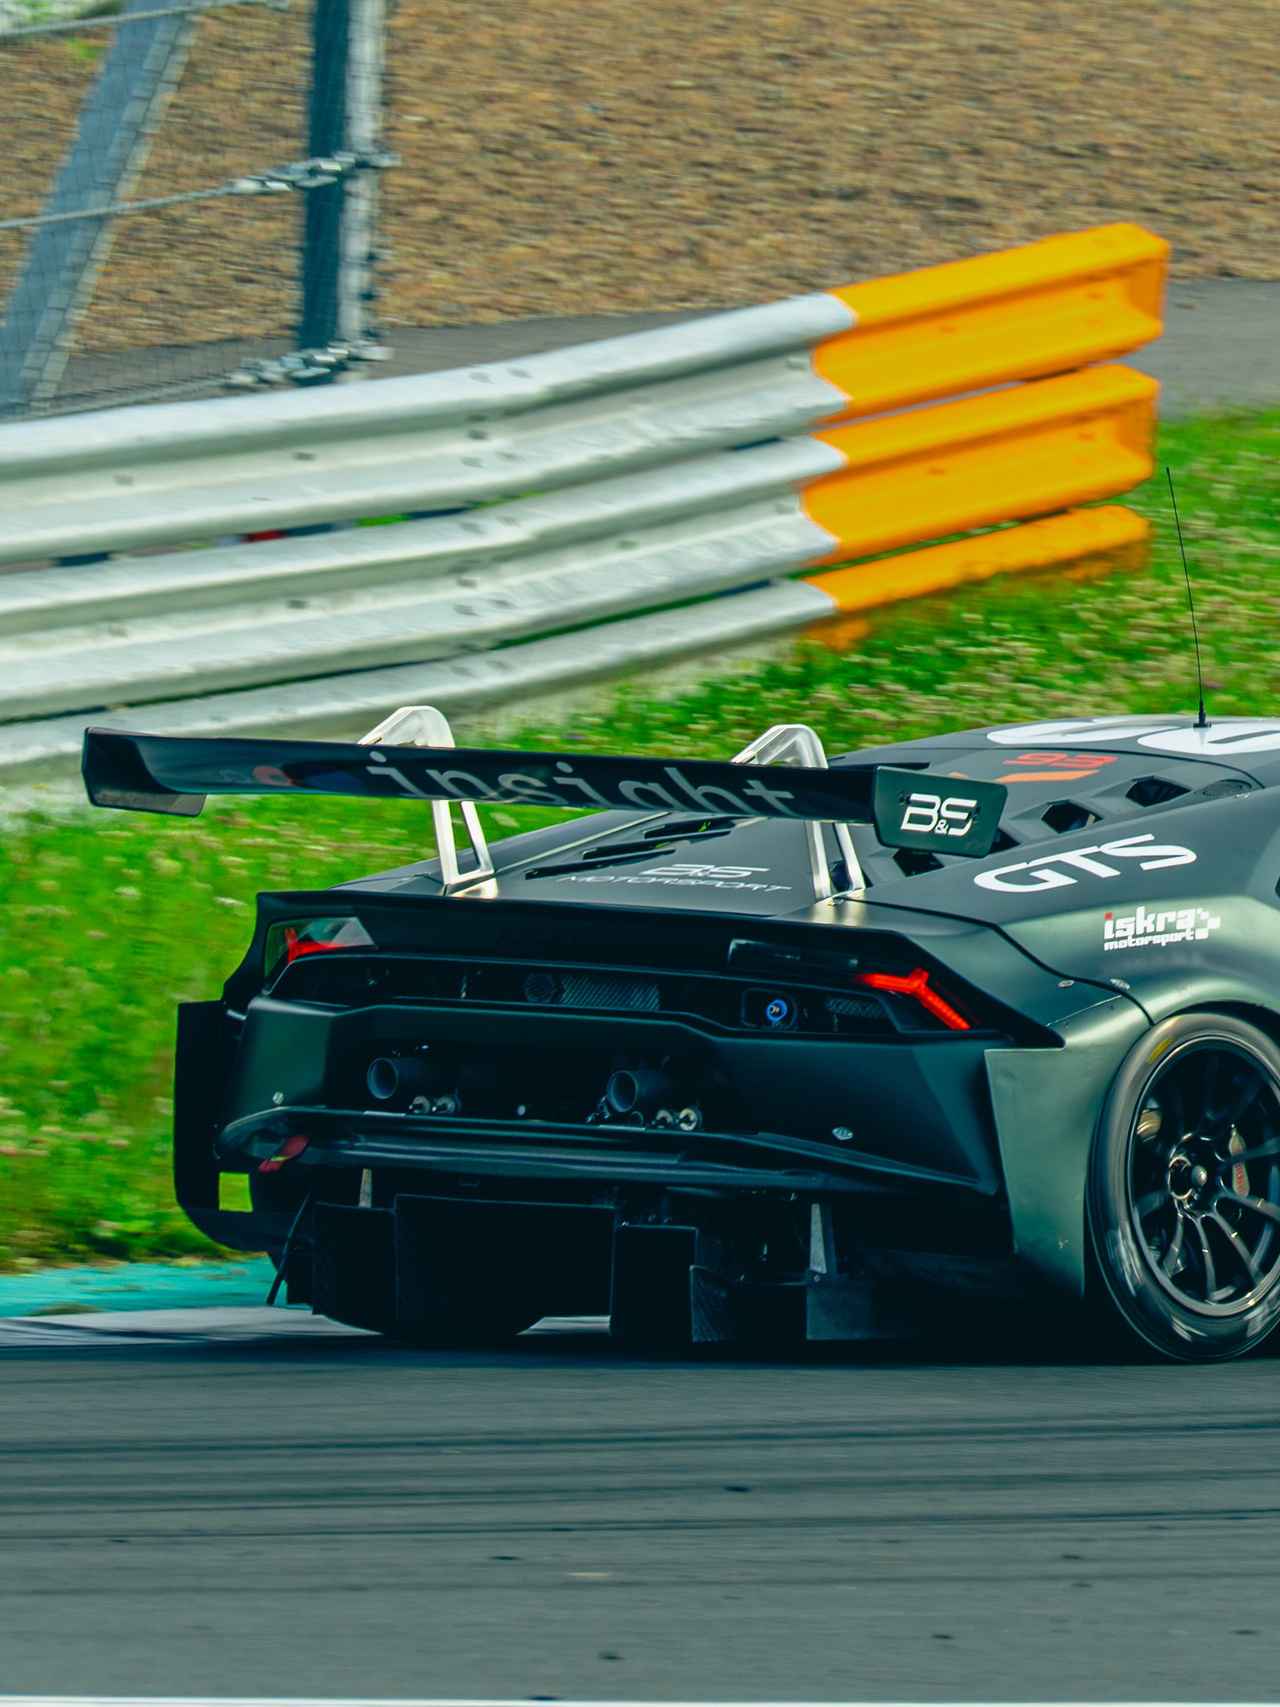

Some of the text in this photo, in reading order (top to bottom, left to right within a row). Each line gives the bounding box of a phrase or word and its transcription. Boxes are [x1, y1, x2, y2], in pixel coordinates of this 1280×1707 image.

[1001, 752, 1118, 769] 93
[900, 793, 978, 837] B&S
[973, 833, 1197, 893] GTS
[556, 875, 793, 892] MOTORSPORT
[1103, 928, 1195, 952] motorsport
